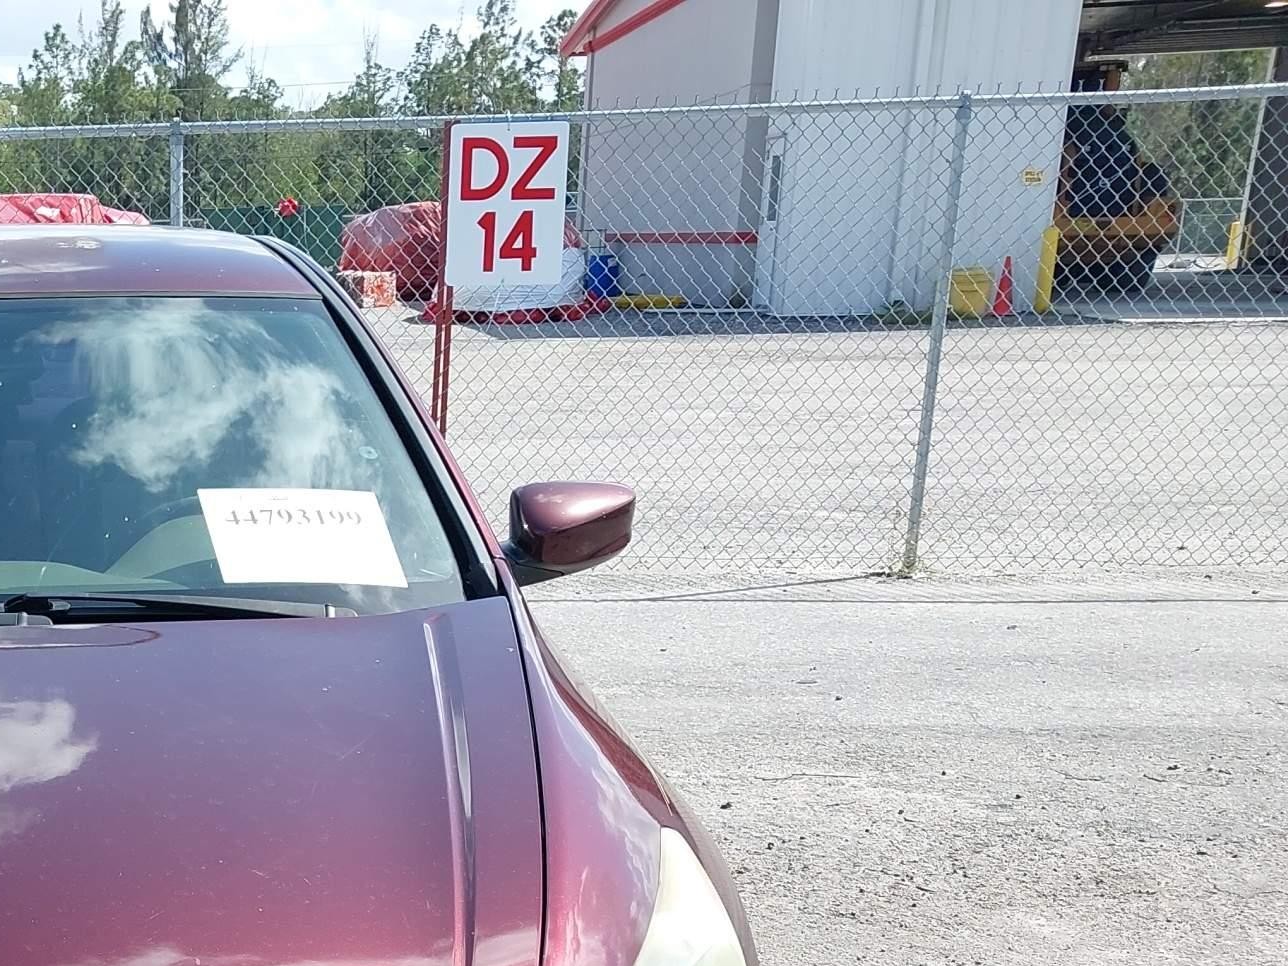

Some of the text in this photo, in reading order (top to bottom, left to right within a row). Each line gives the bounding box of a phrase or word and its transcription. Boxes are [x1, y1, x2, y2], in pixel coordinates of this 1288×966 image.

[460, 136, 559, 201] DZ
[476, 210, 537, 272] 14
[225, 509, 363, 525] 44793199
